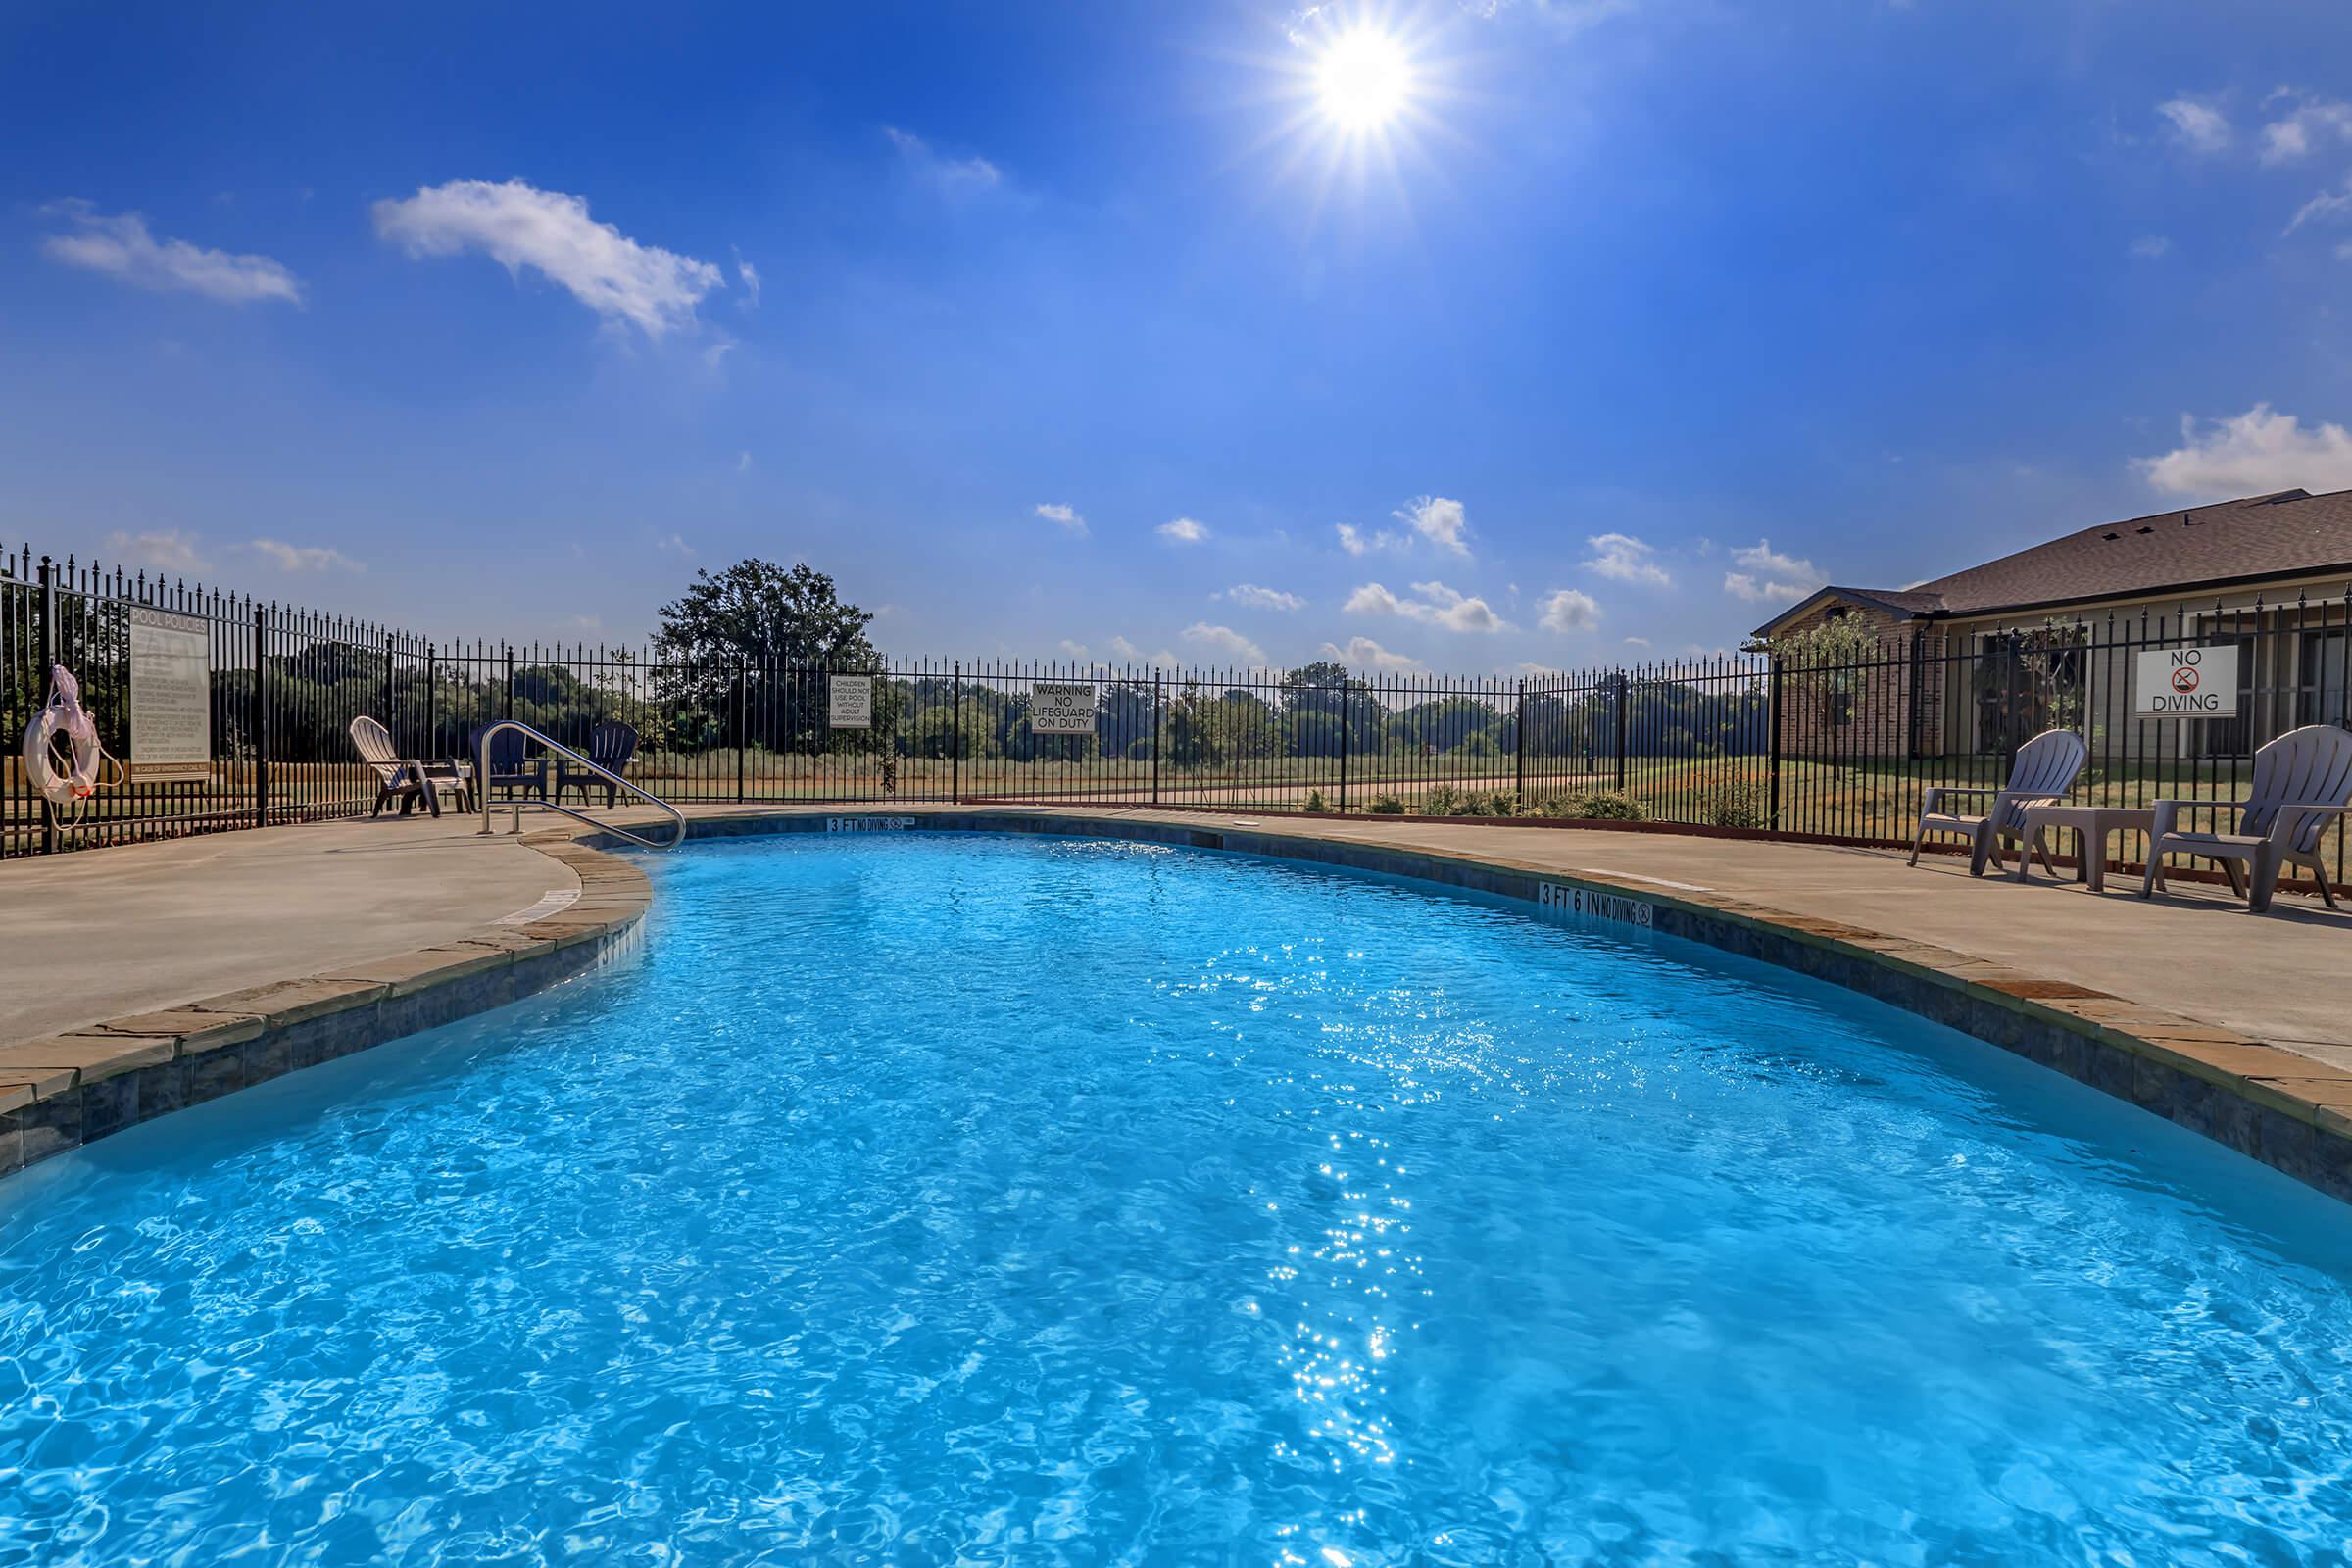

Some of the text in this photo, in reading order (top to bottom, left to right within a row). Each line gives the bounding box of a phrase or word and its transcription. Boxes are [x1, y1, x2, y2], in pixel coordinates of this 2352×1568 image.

[132, 609, 206, 634] POOL POLICIES
[2171, 649, 2202, 666] NO
[1036, 685, 1091, 697] WARNING
[1054, 696, 1073, 707] NO
[2152, 694, 2219, 711] DIVING
[1033, 707, 1095, 718] LIFEGUARD
[1038, 717, 1090, 728] ON DUTY
[831, 818, 889, 832] 3 FT NO DIVING
[1544, 884, 1636, 925] 3 FT 6 IN NO DIVING
